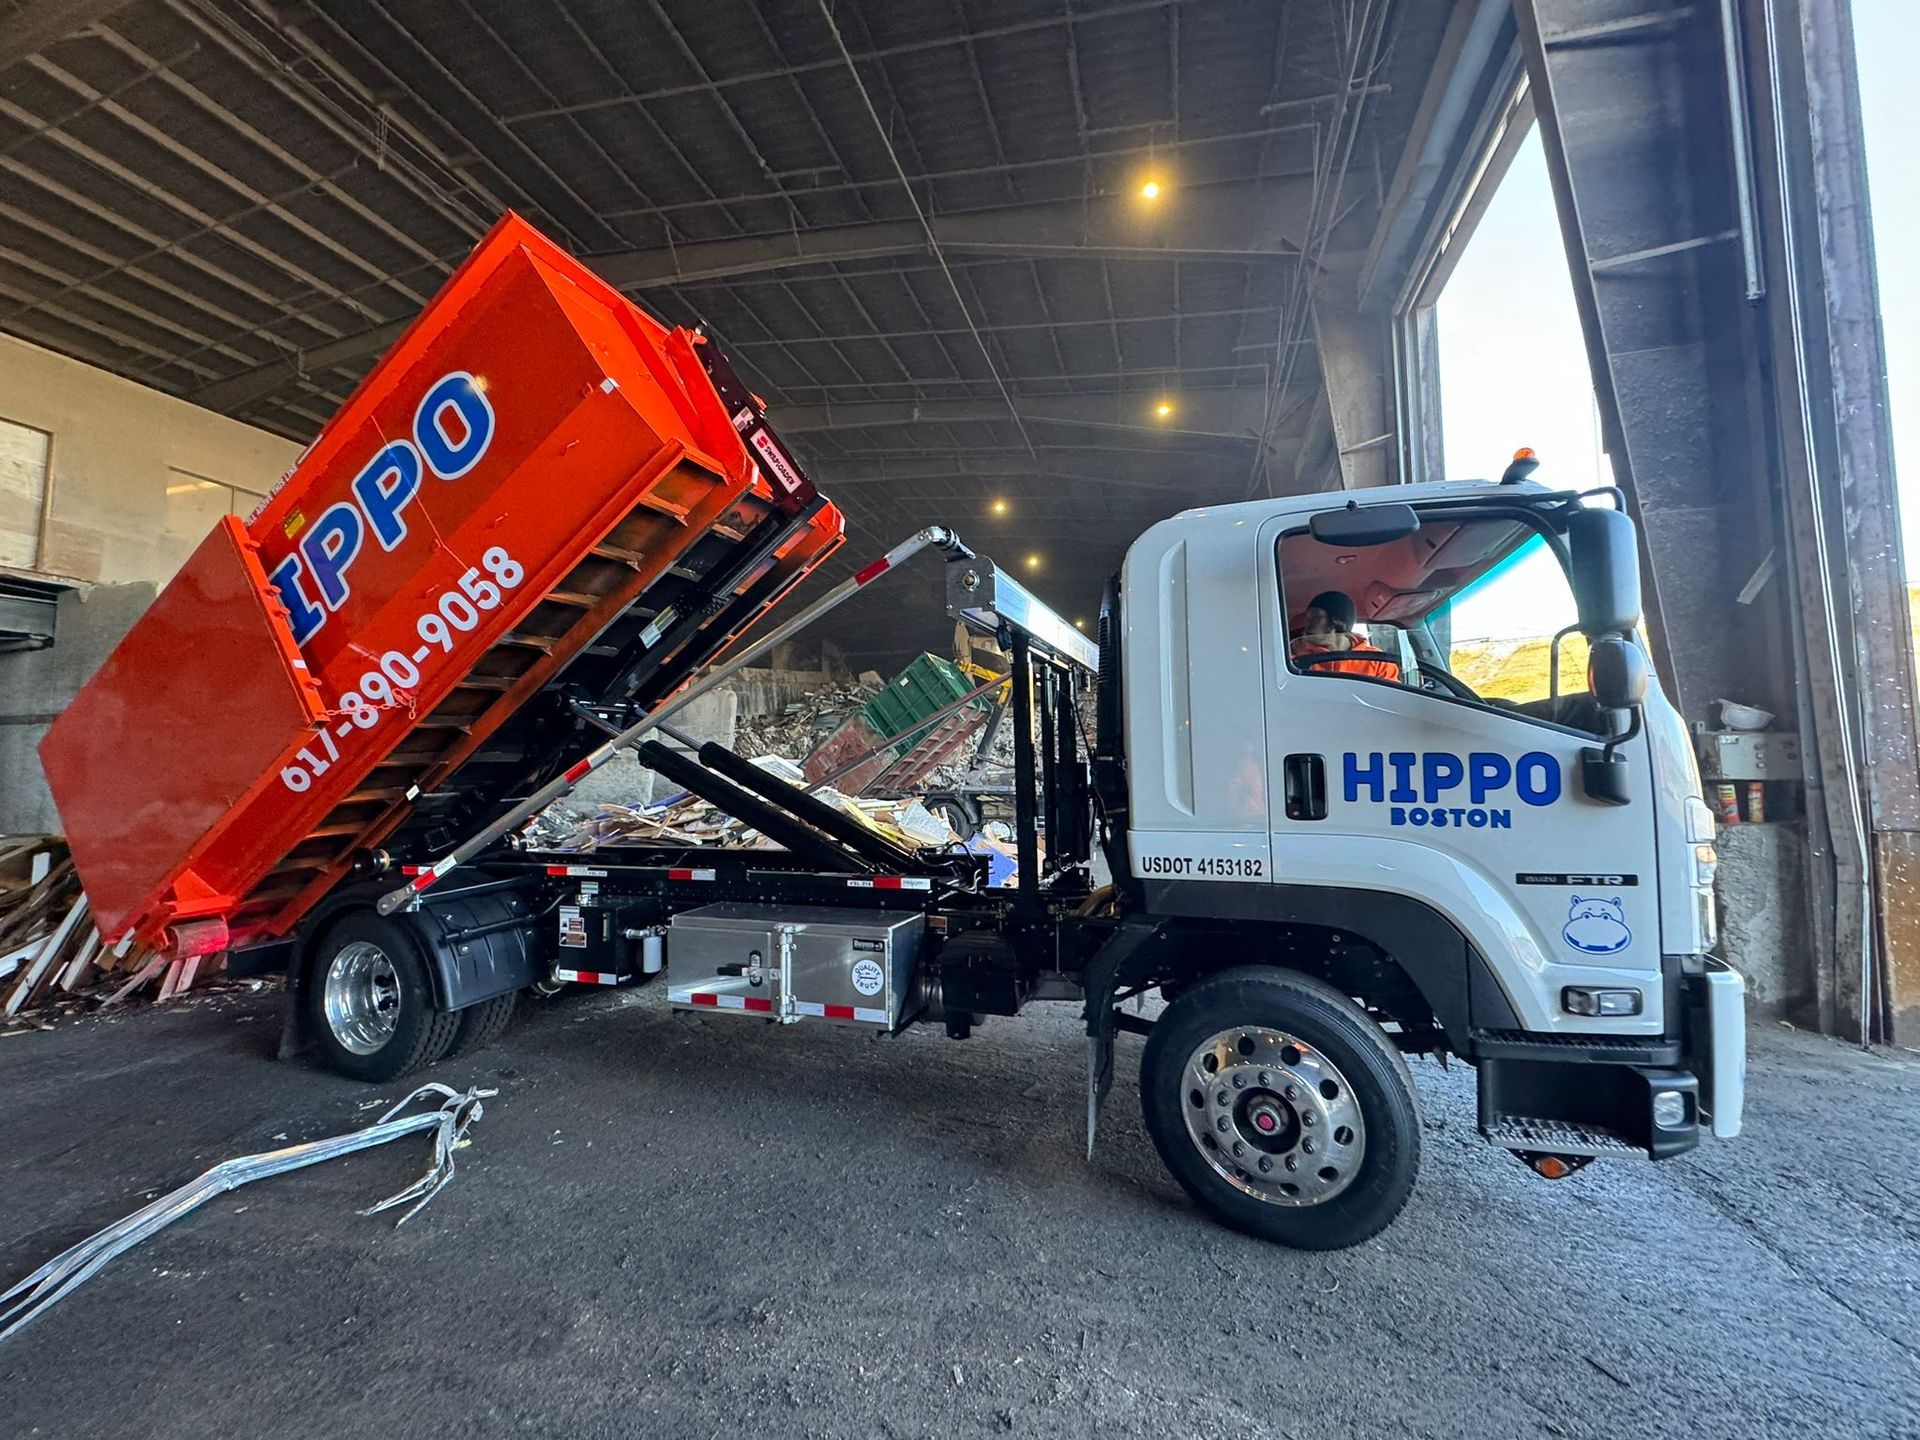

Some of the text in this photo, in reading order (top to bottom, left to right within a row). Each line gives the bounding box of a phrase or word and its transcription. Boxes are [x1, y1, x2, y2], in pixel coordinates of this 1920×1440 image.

[268, 370, 496, 649] IPPO
[1342, 751, 1562, 807] HIPPO
[1390, 807, 1512, 829] BOSTON
[1142, 856, 1263, 877] USDOT 4153182
[1565, 875, 1624, 886] FTR
[855, 964, 881, 976] QUALITY
[856, 979, 880, 989] TRUCK
